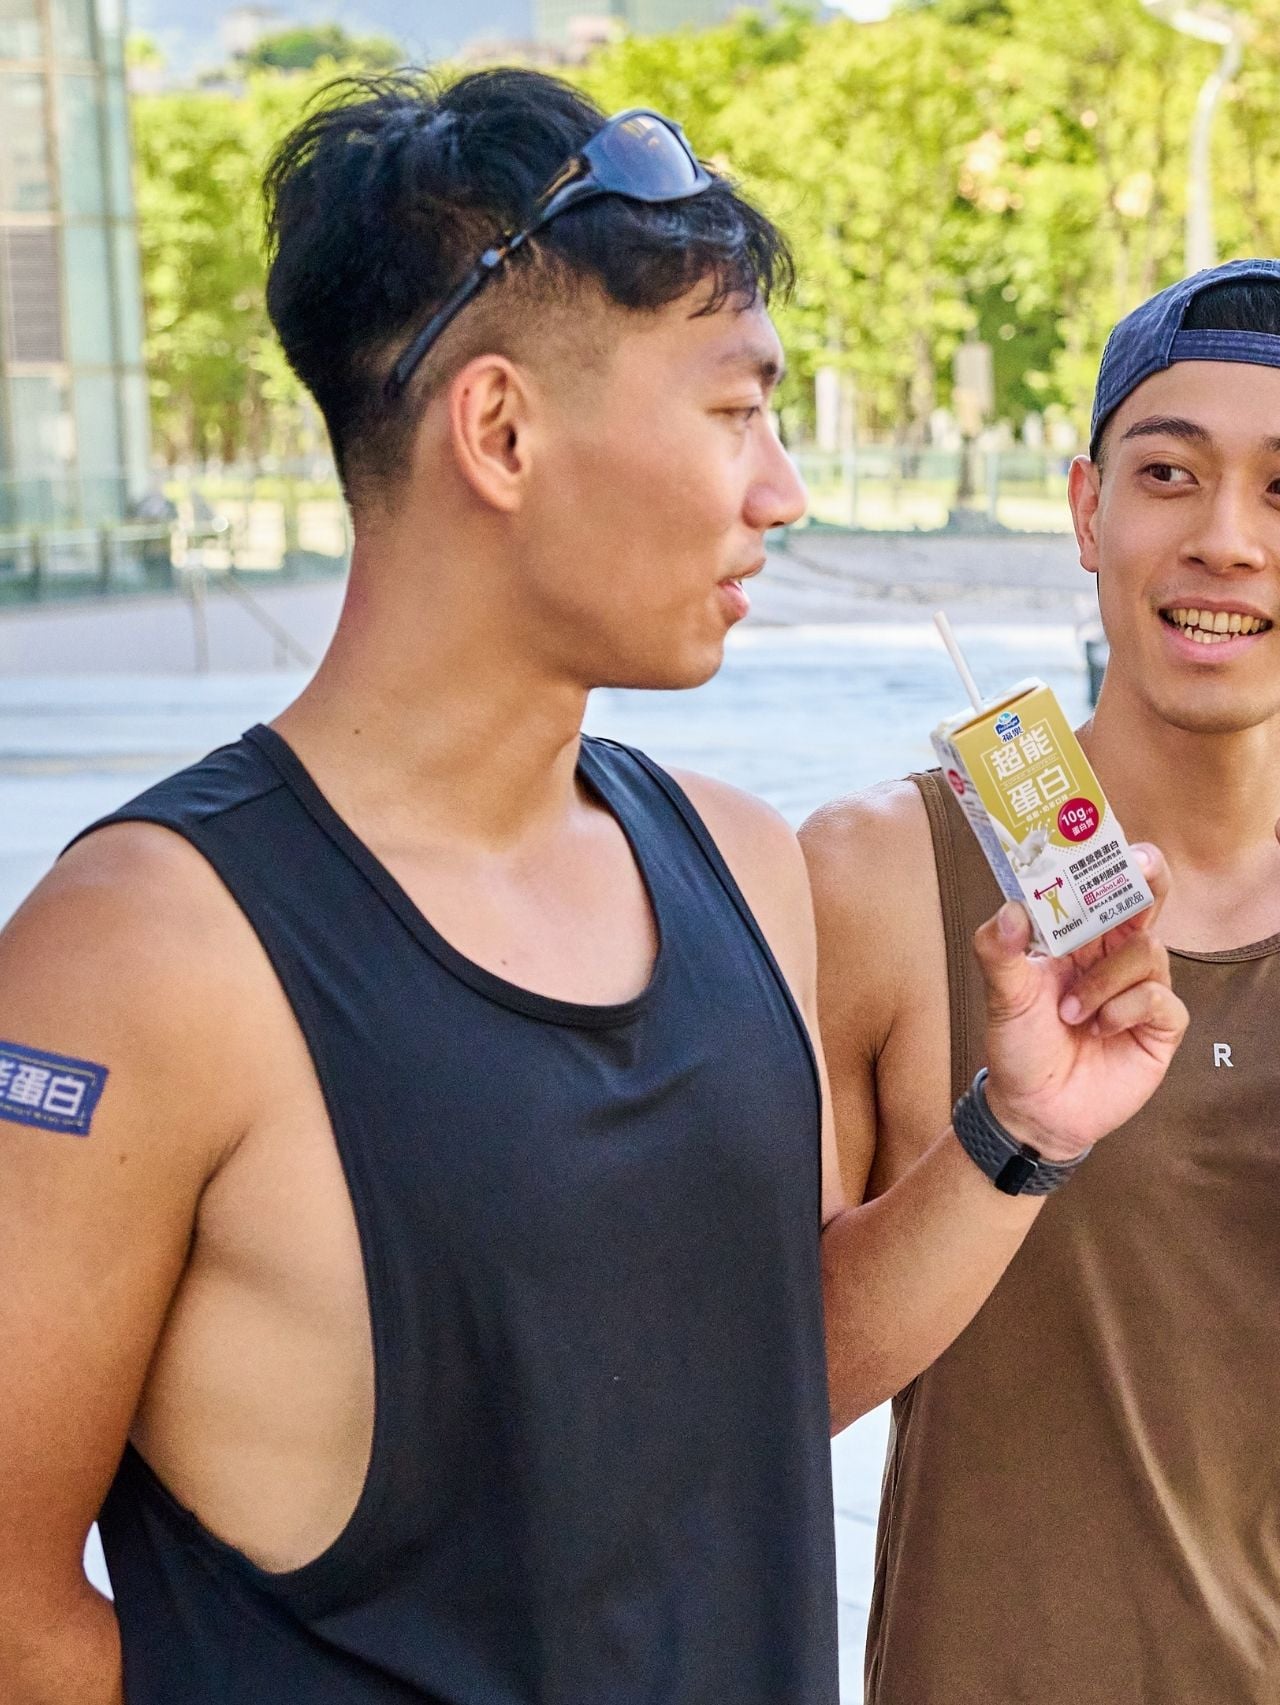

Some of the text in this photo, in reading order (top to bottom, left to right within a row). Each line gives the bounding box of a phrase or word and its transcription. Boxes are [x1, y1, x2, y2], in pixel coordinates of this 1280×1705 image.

[990, 728, 1053, 781] 超能
[1007, 764, 1070, 818] 蛋白
[1072, 821, 1094, 837] 蛋白質
[1069, 840, 1119, 874] 四重營養蛋白
[1079, 861, 1128, 894] 日本專利胺基酸
[1099, 892, 1144, 924] 保久乳飲品
[1052, 917, 1083, 940] Protein
